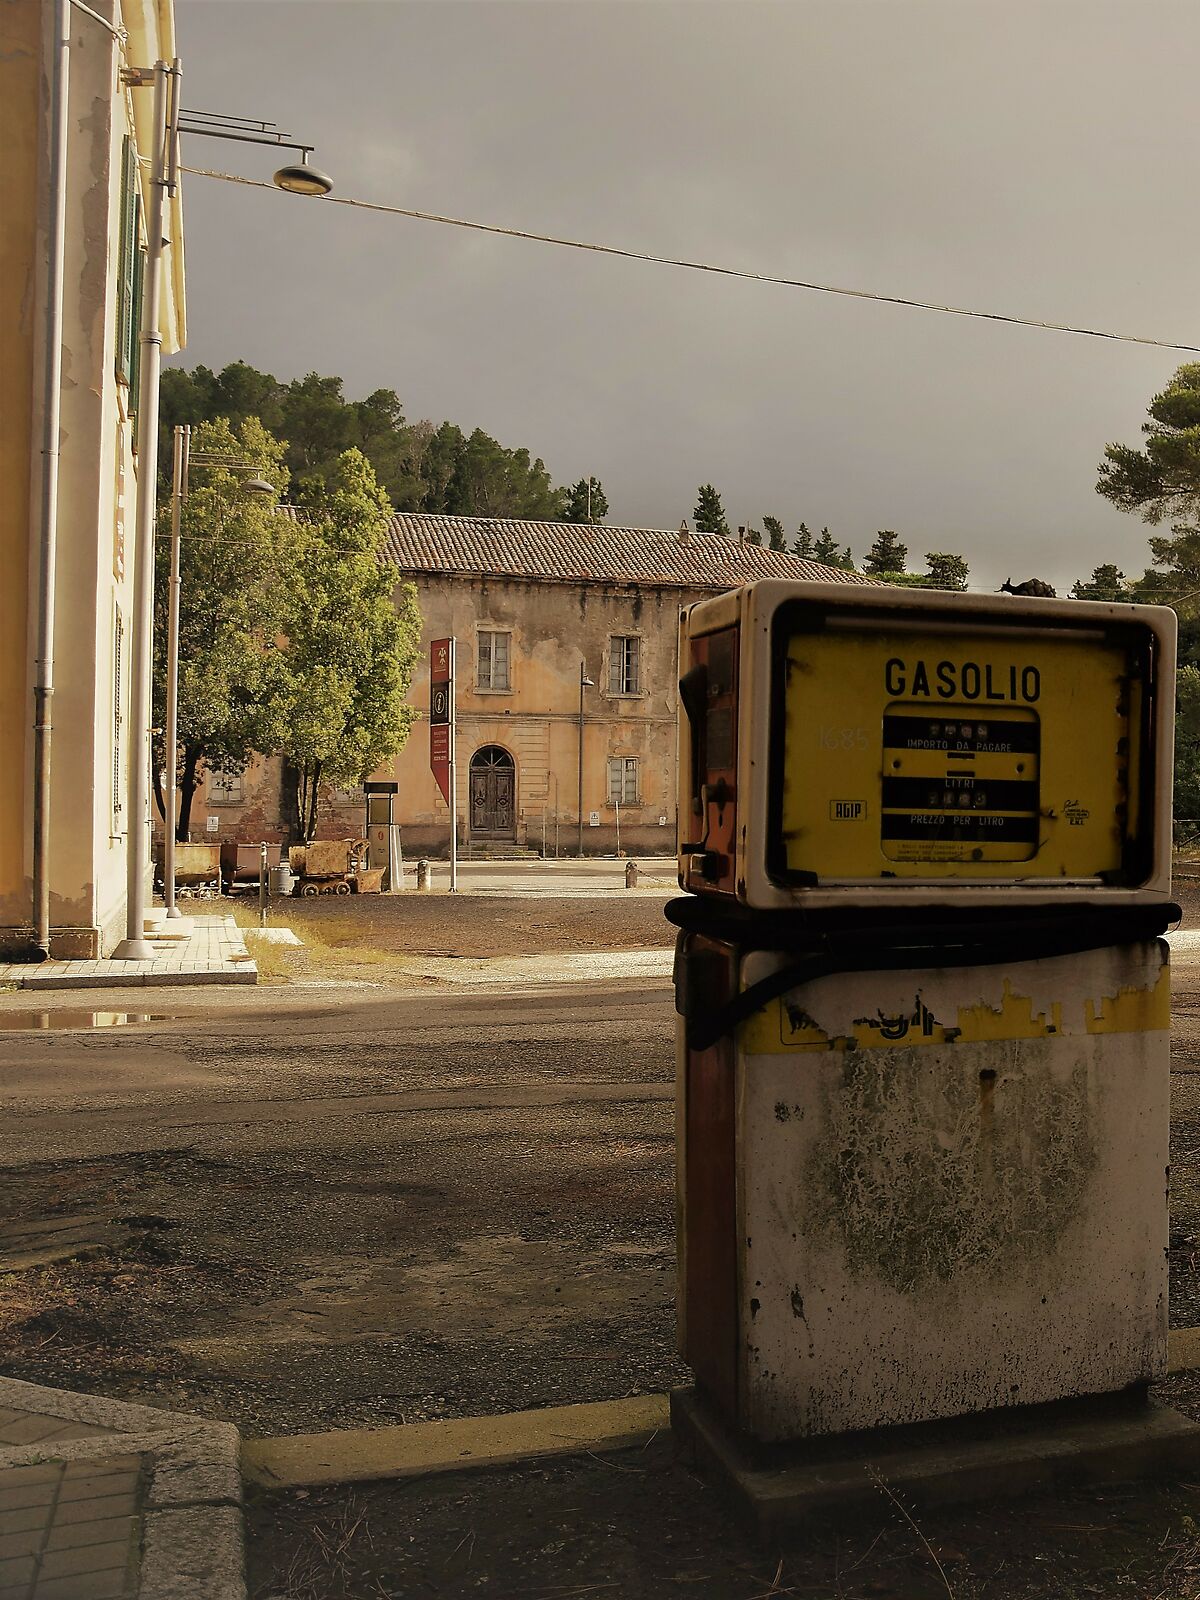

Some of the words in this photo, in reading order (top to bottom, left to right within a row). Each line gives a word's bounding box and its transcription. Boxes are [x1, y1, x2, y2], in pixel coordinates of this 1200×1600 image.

[886, 658, 1041, 702] GASOLIO
[819, 724, 870, 752] 1685
[907, 739, 948, 751] IMPORTO
[956, 741, 969, 751] DA
[976, 742, 1013, 753] PAGARE
[945, 779, 974, 789] LITRI
[836, 803, 861, 818] AGIP
[910, 815, 945, 825] PREZZO
[953, 816, 971, 825] PER
[979, 816, 1005, 826] LITRO
